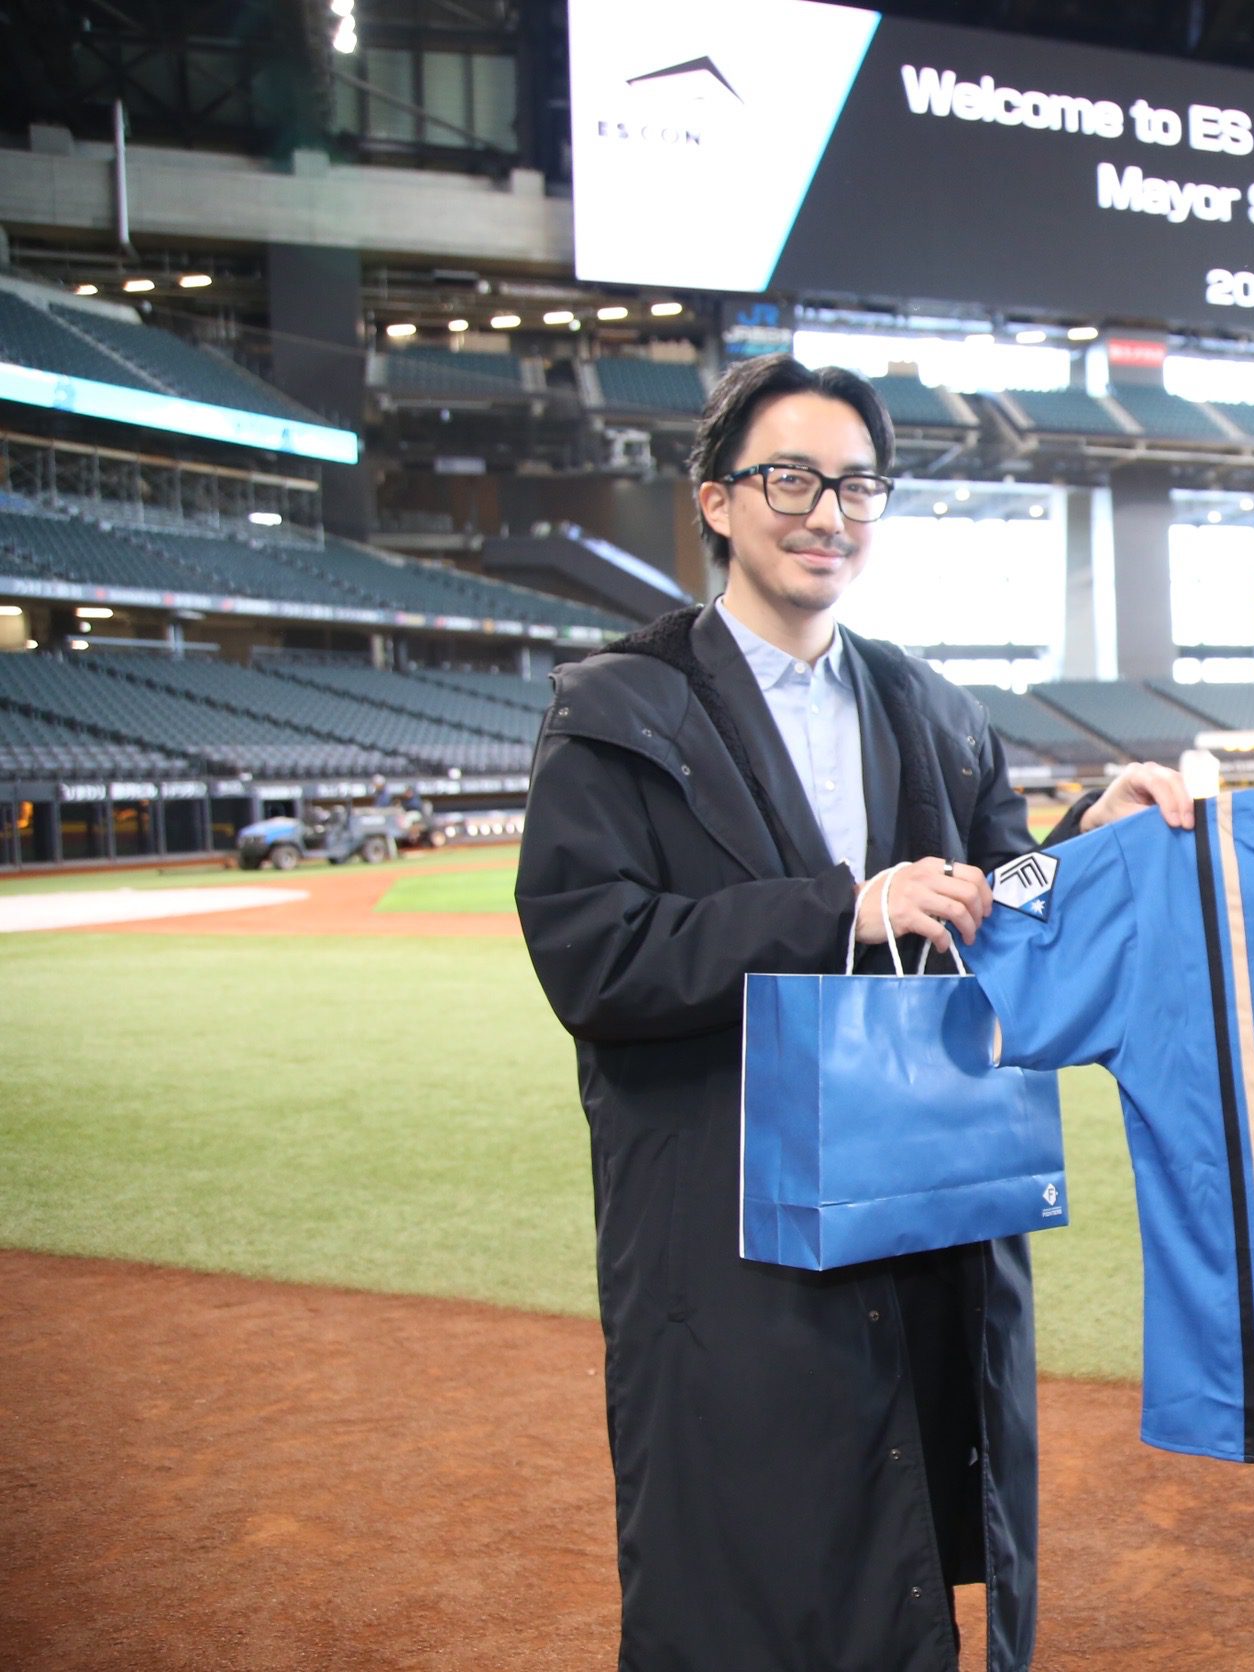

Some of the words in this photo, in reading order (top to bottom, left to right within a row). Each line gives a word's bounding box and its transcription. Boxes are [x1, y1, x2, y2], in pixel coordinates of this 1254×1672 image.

[902, 65, 1124, 138] Welcome
[1130, 100, 1182, 145] to
[1189, 105, 1254, 155] ES
[1098, 163, 1241, 223] Mayor
